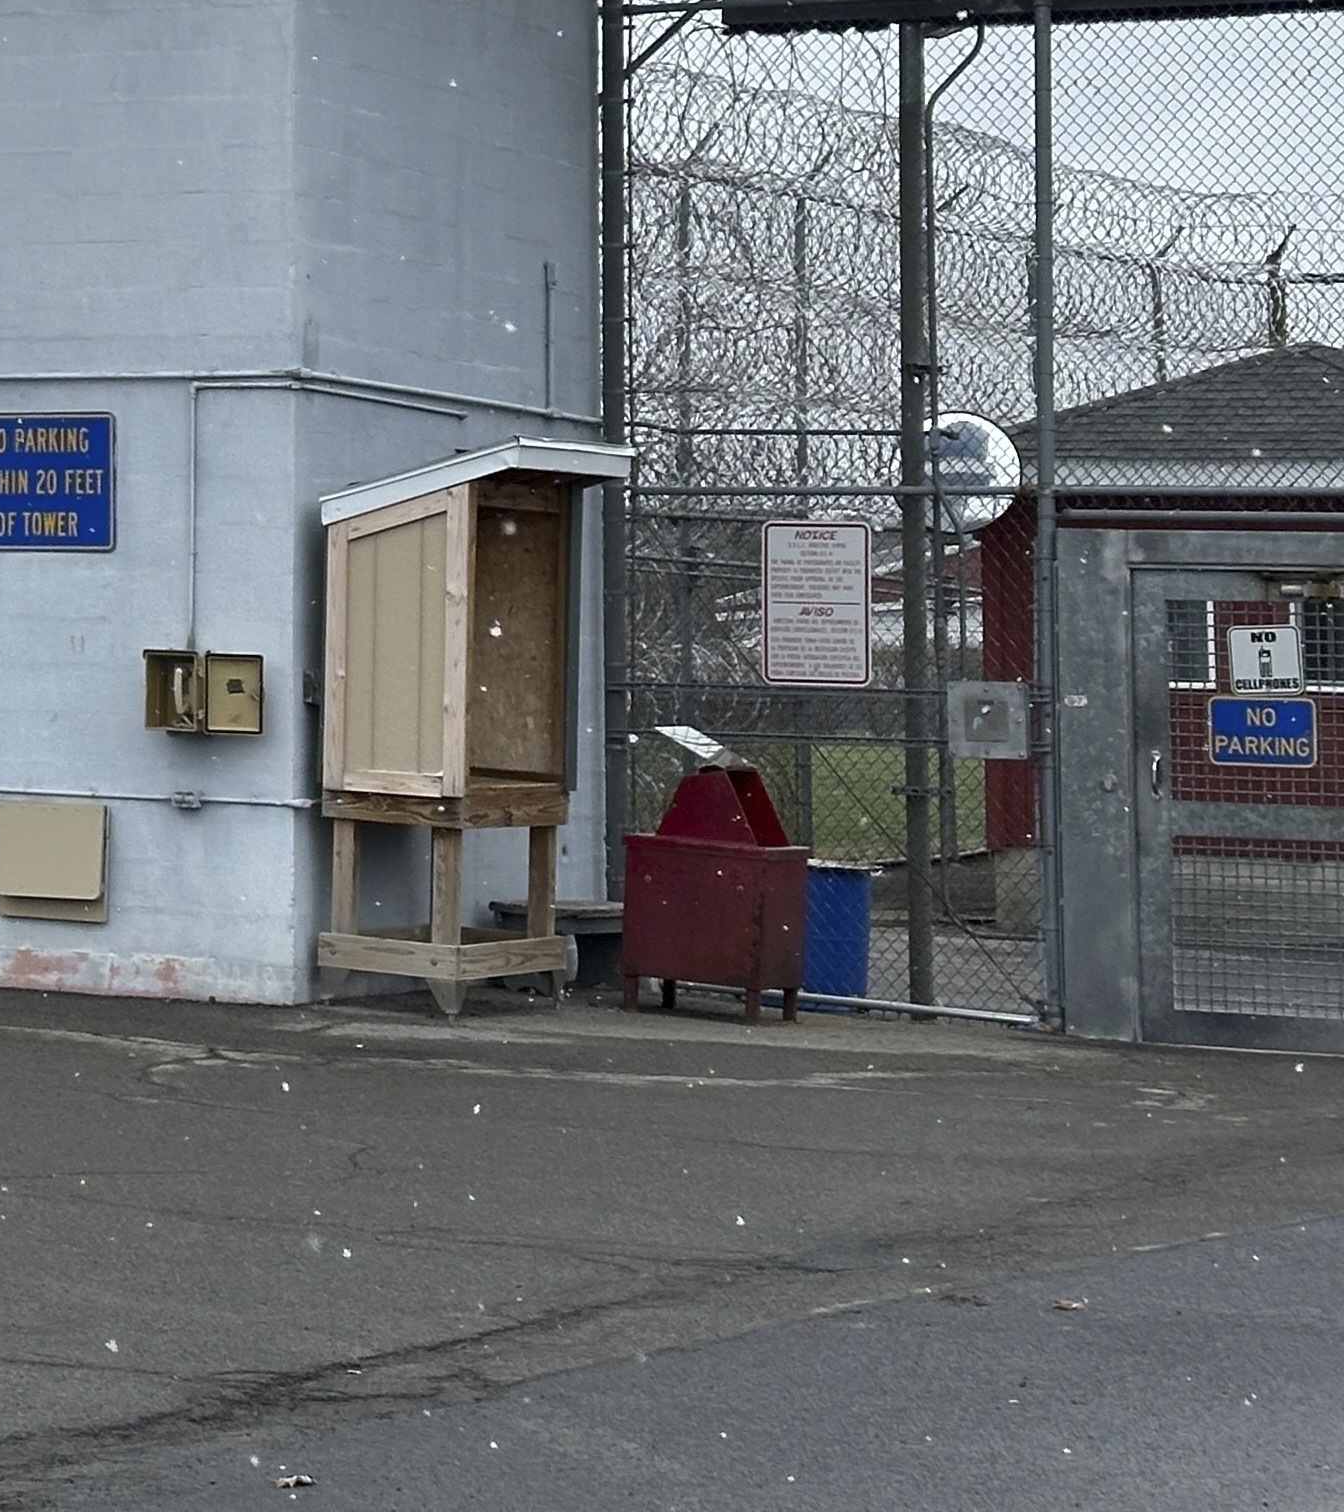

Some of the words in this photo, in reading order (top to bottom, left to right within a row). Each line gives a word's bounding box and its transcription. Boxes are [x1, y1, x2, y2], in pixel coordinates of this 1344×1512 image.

[14, 426, 90, 454] PARKING
[36, 469, 58, 496] 20
[64, 469, 104, 496] FEET
[22, 511, 79, 538] TOWER
[794, 530, 838, 541] NOTICE
[798, 606, 835, 617] AVISO
[1250, 631, 1277, 644] NO
[1235, 677, 1300, 690] CELLPHONES
[1246, 707, 1277, 727] NO
[1214, 734, 1311, 758] PARKING
